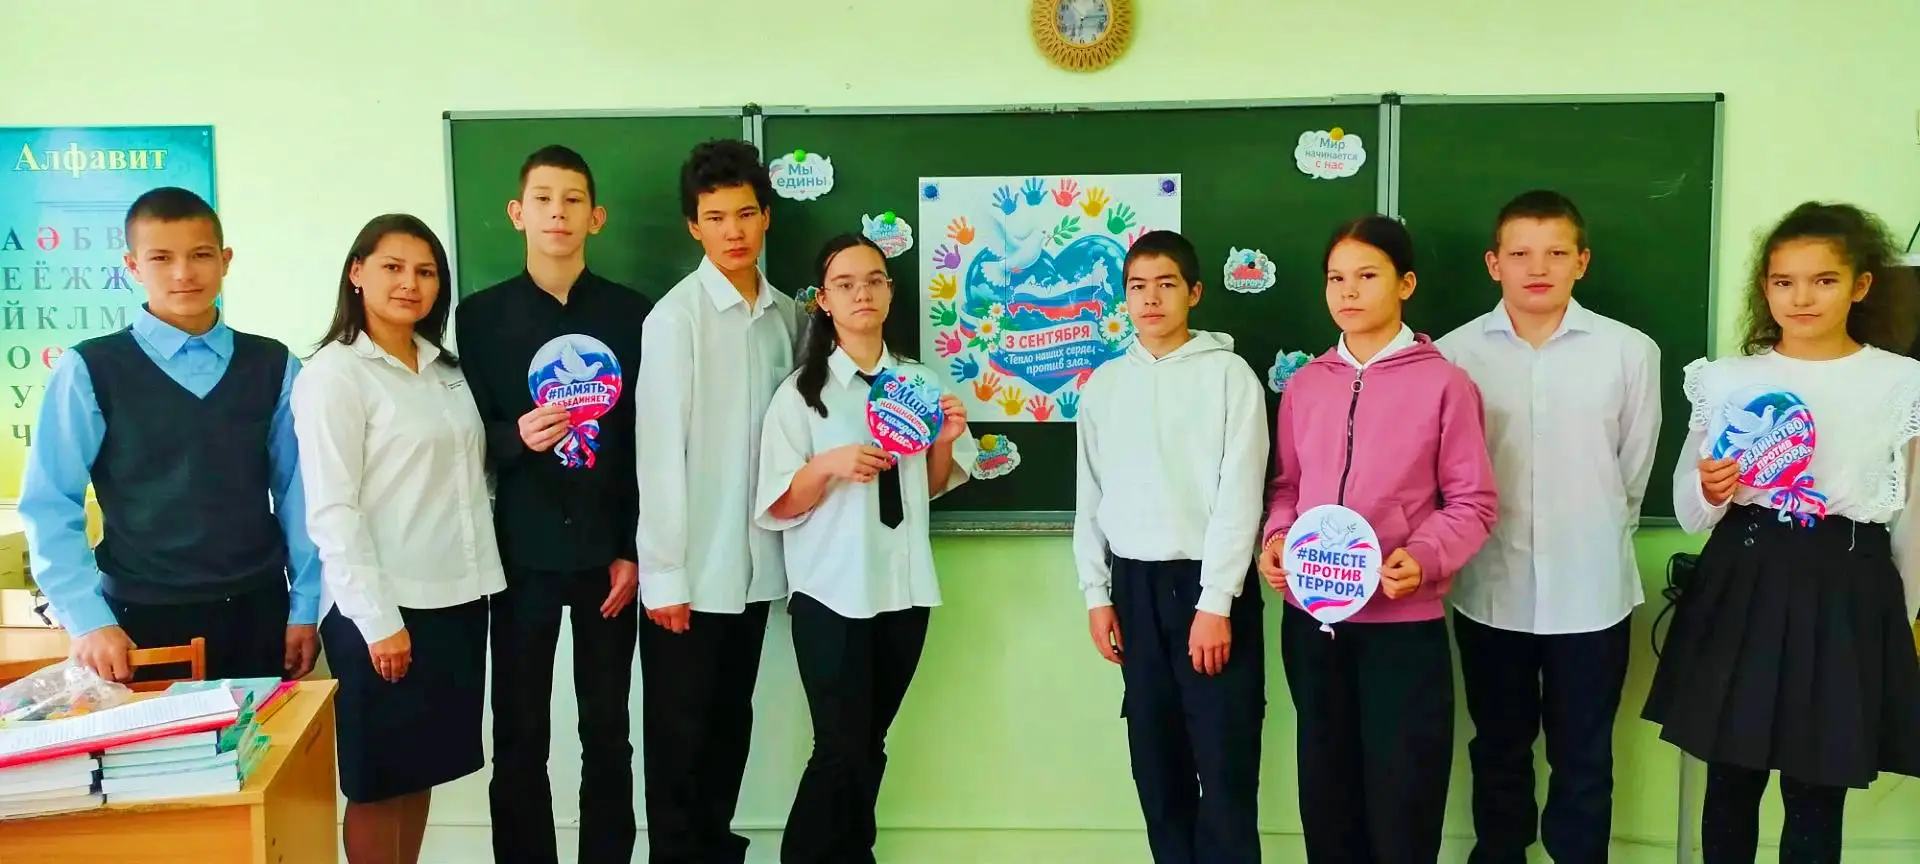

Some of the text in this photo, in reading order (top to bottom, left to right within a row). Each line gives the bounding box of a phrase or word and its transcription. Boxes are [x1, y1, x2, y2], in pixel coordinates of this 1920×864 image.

[1319, 137, 1346, 151] Мир
[13, 142, 169, 178] Алфавит
[1305, 150, 1359, 160] начинается
[1315, 160, 1344, 170] с нас
[788, 163, 813, 175] Мы
[776, 176, 827, 189] едины
[1, 226, 25, 252] А
[72, 226, 93, 251] Б
[1, 265, 23, 291] Е
[31, 260, 53, 290] Ё
[61, 266, 93, 290] Ж
[3, 299, 26, 330] Й
[36, 305, 59, 330] К
[67, 306, 90, 330] Л
[1005, 324, 1091, 349] 3 СЕНТЯБРЯ
[1035, 347, 1065, 361] наших
[1025, 358, 1065, 376] против
[548, 382, 606, 400] #ПАМЯТЬ
[885, 384, 928, 416] #Мир
[1739, 419, 1804, 473] #ЕДИНСТВО
[1756, 439, 1793, 470] ПРОТИВ
[1296, 547, 1367, 568] #ВМЕСТЕ
[1301, 562, 1362, 582] ПРОТИВ
[1296, 573, 1365, 598] ТЕРРОРА
